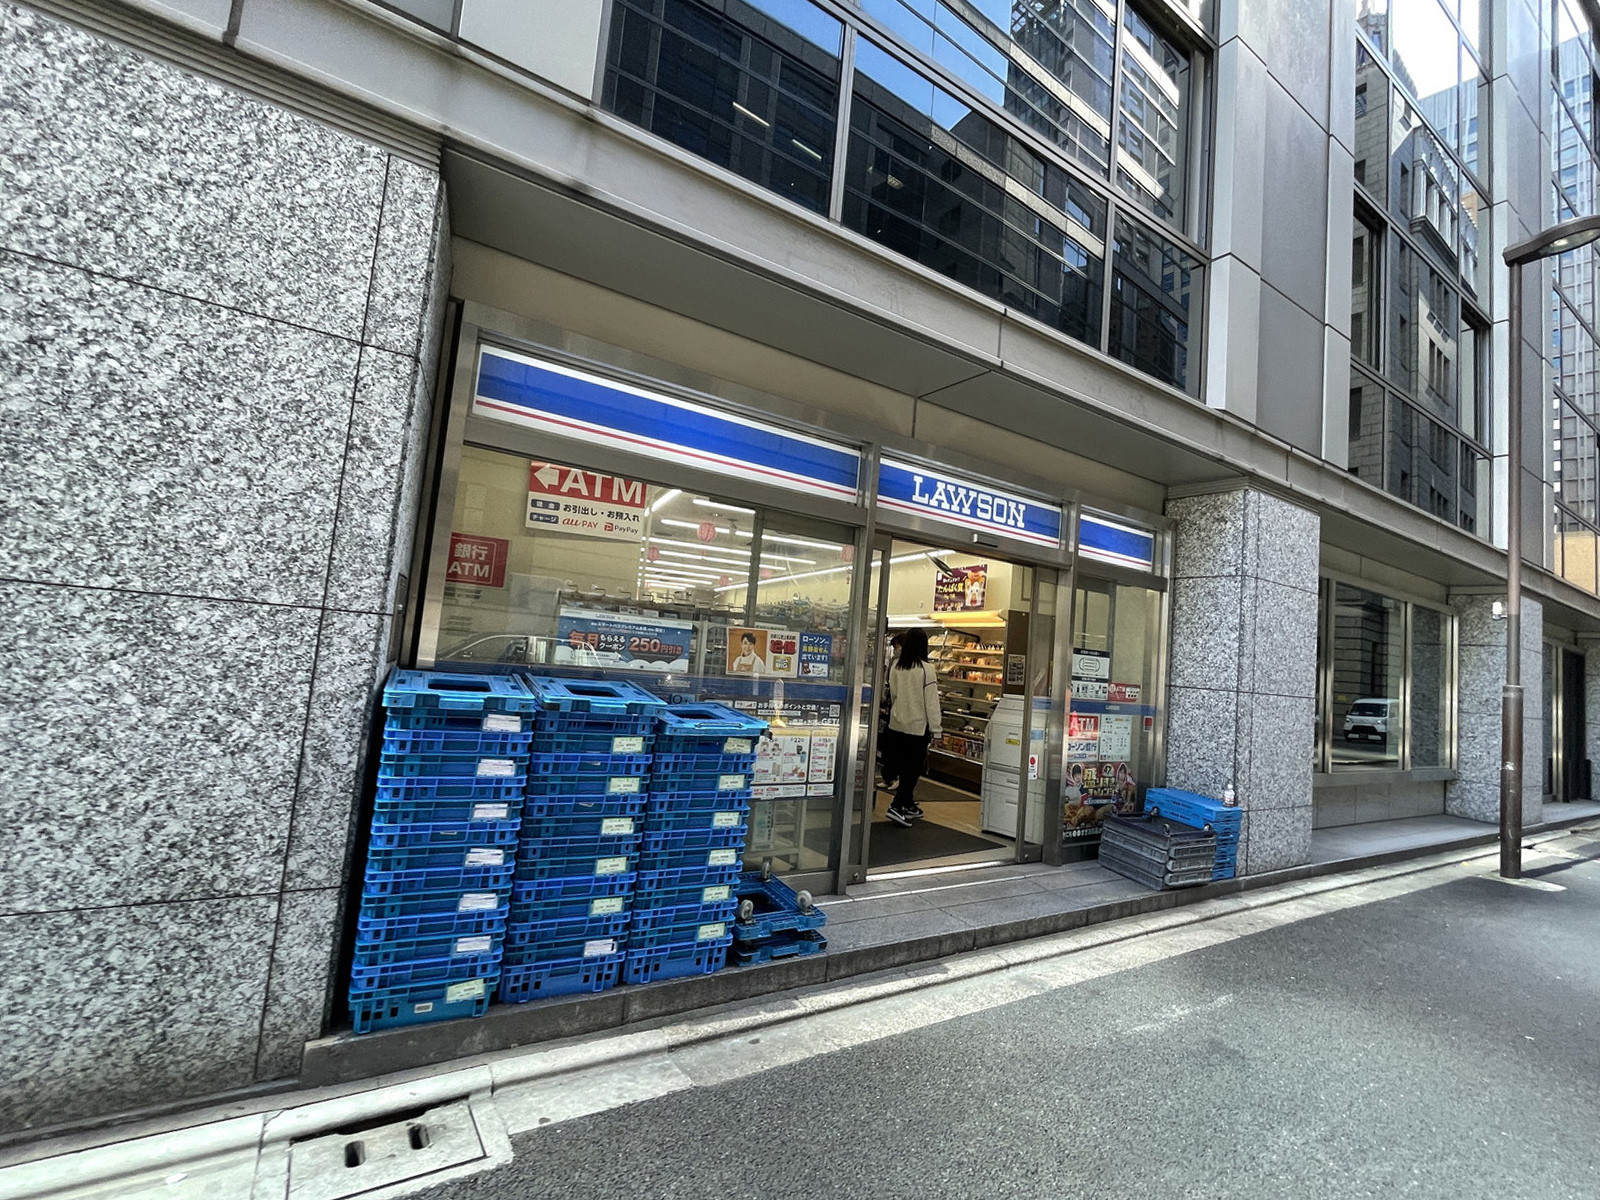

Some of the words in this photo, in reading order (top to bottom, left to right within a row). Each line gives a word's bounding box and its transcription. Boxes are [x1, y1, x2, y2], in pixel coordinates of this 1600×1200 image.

[560, 468, 642, 504] ATM
[912, 475, 1027, 528] LAWSON
[581, 520, 598, 529] PAY
[614, 525, 638, 535] PayPay
[454, 542, 488, 560] 銀行
[448, 561, 490, 578] ATM
[600, 634, 626, 643] もらえる
[599, 642, 626, 651] クーポン
[1071, 717, 1095, 732] ATM
